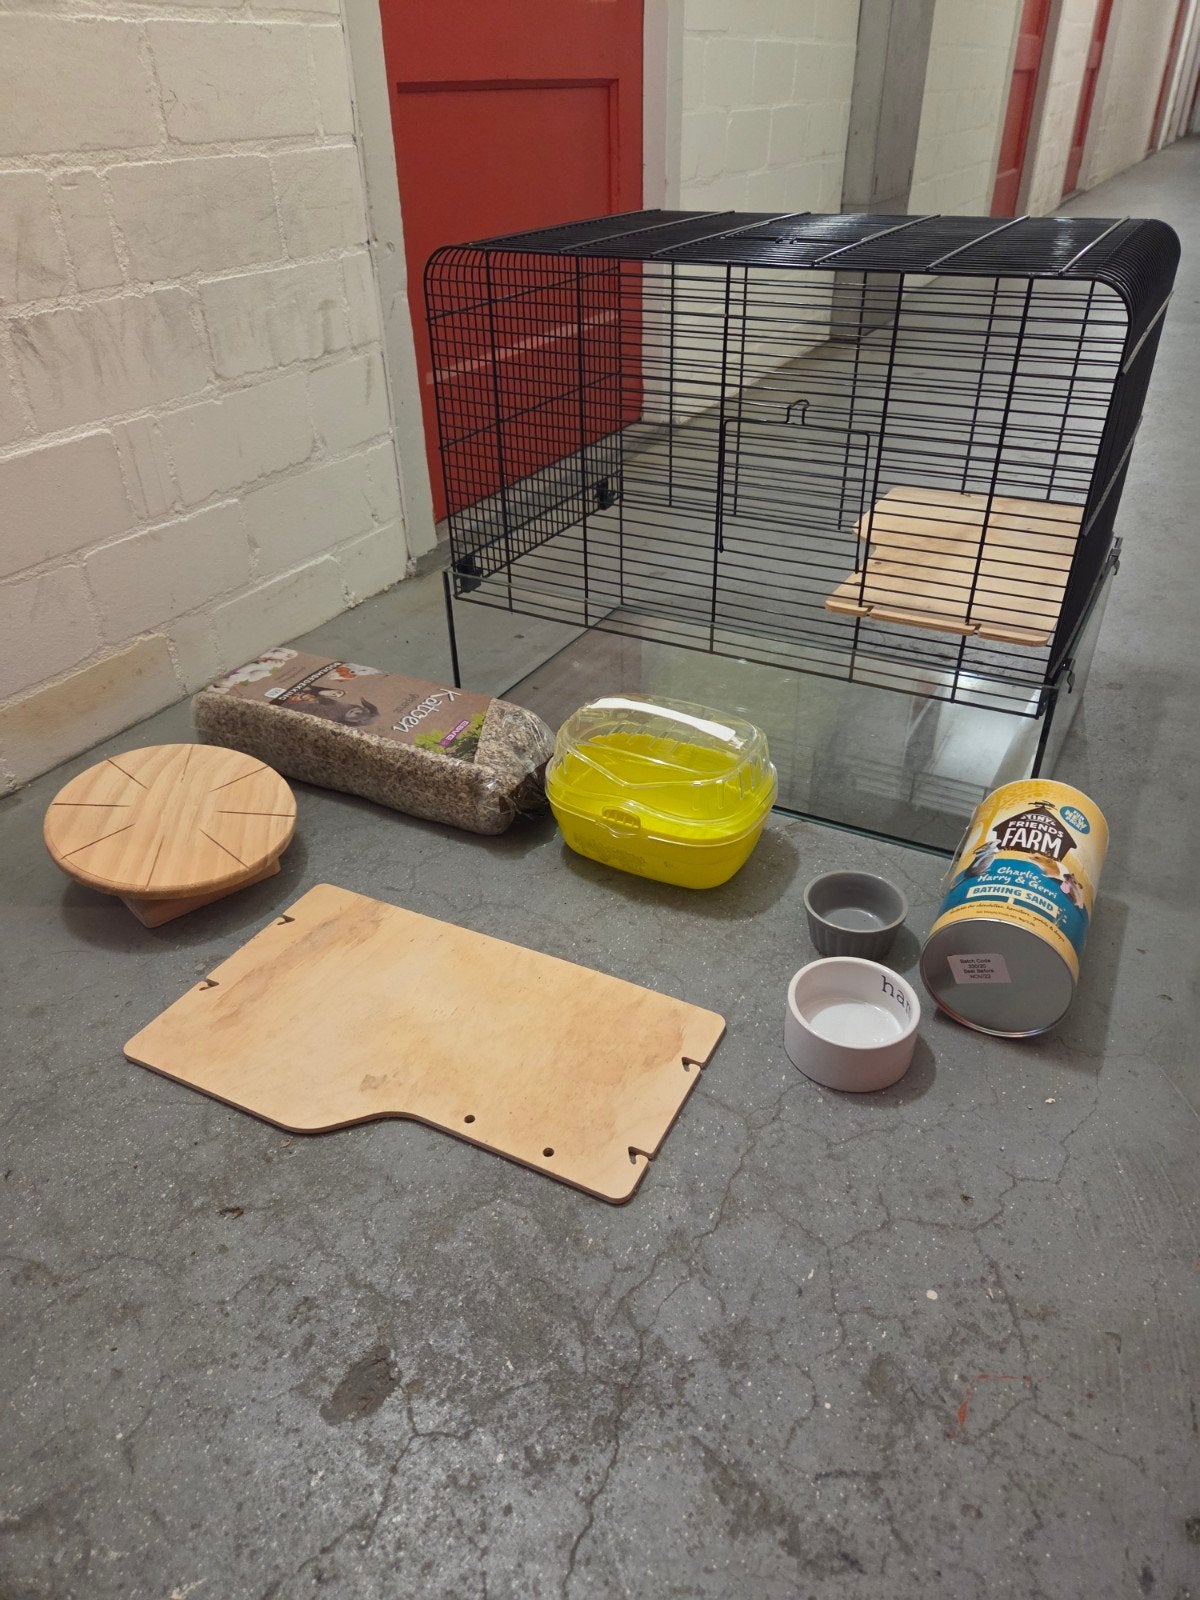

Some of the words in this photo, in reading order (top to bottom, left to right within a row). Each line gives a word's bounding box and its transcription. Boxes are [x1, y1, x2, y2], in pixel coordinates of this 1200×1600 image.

[393, 688, 461, 733] Katoen
[1008, 821, 1064, 838] FRIENDS
[1001, 828, 1062, 859] FARM
[977, 873, 1011, 885] Harry
[1015, 875, 1026, 885] &
[1028, 880, 1058, 899] Gerri
[997, 866, 1042, 883] Charlie,
[973, 885, 1023, 897] BATHING
[1025, 892, 1055, 912] SAND
